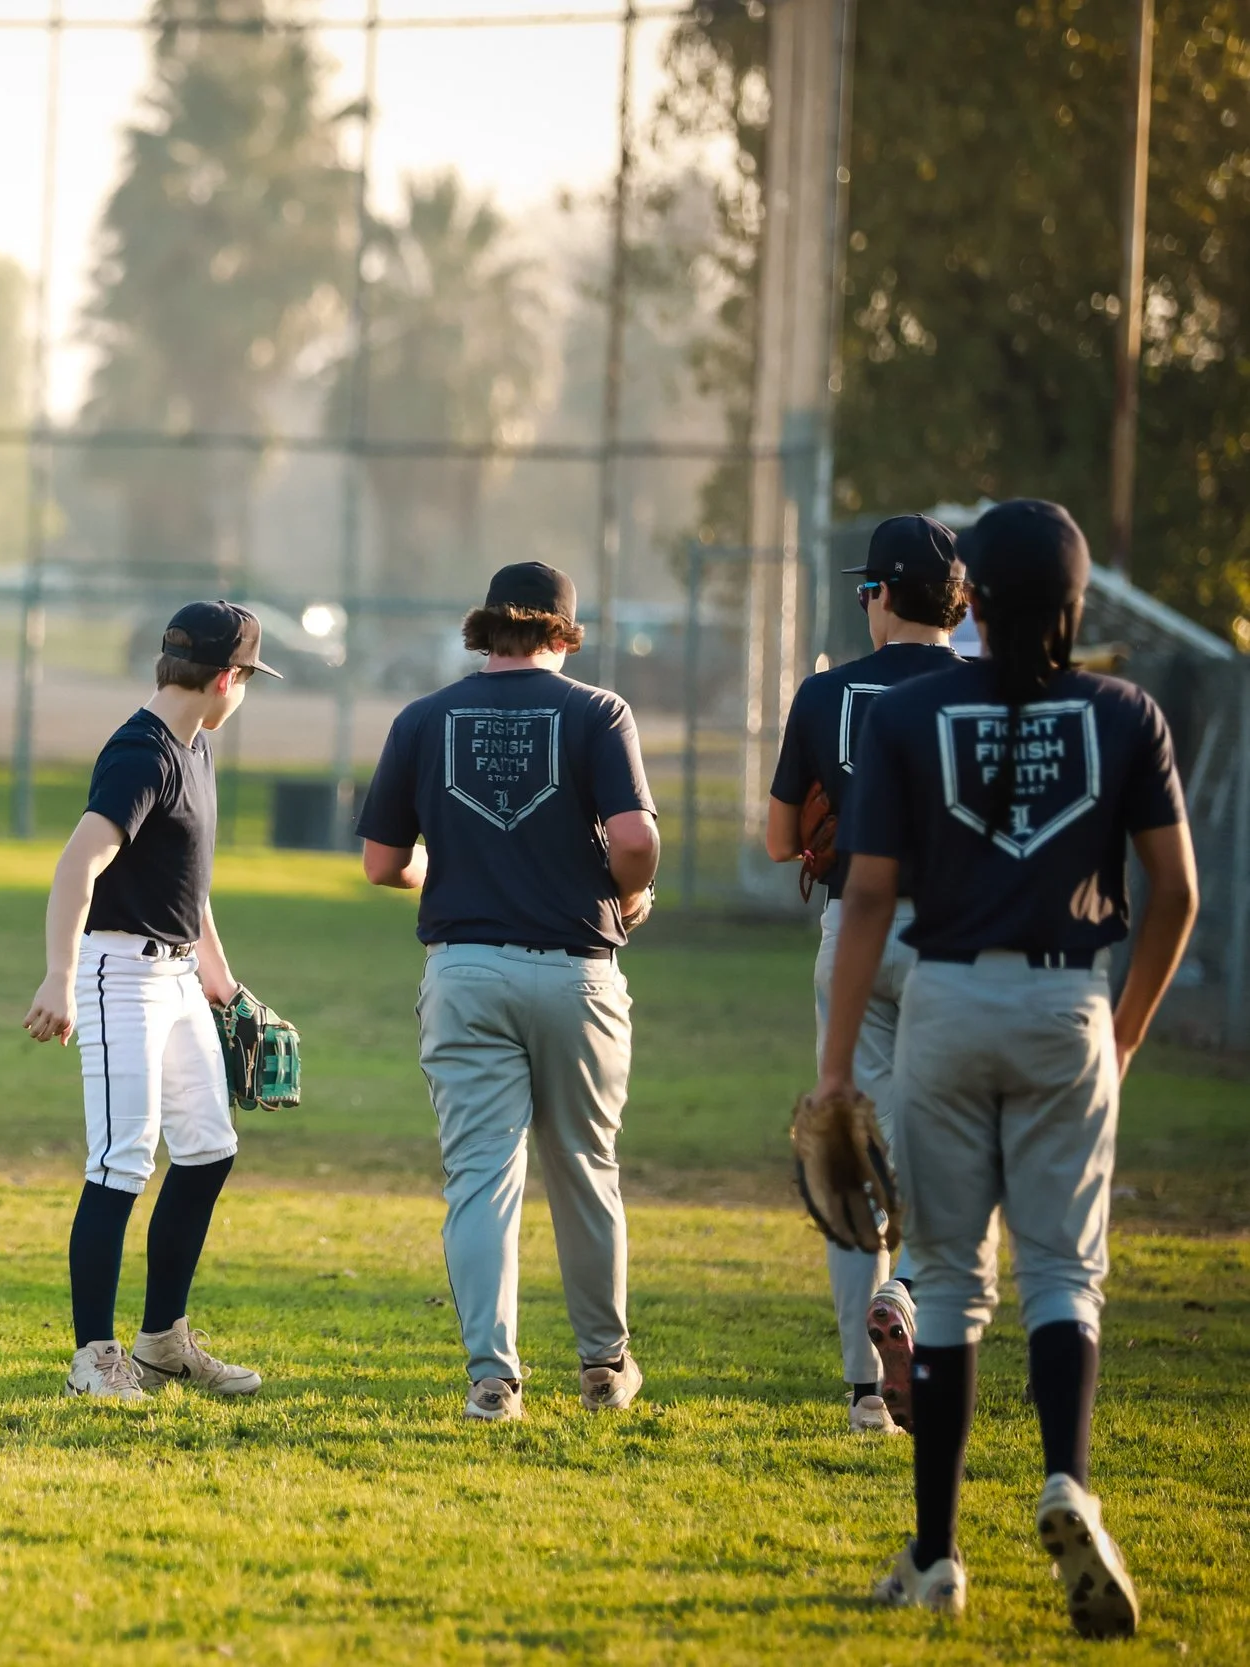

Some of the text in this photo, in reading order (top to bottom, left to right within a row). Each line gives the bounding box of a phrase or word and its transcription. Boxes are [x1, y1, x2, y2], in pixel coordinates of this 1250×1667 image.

[474, 720, 531, 735] FIGHT
[471, 739, 533, 754] FINISH
[476, 757, 528, 772] FAITH
[982, 762, 1059, 784] FITH
